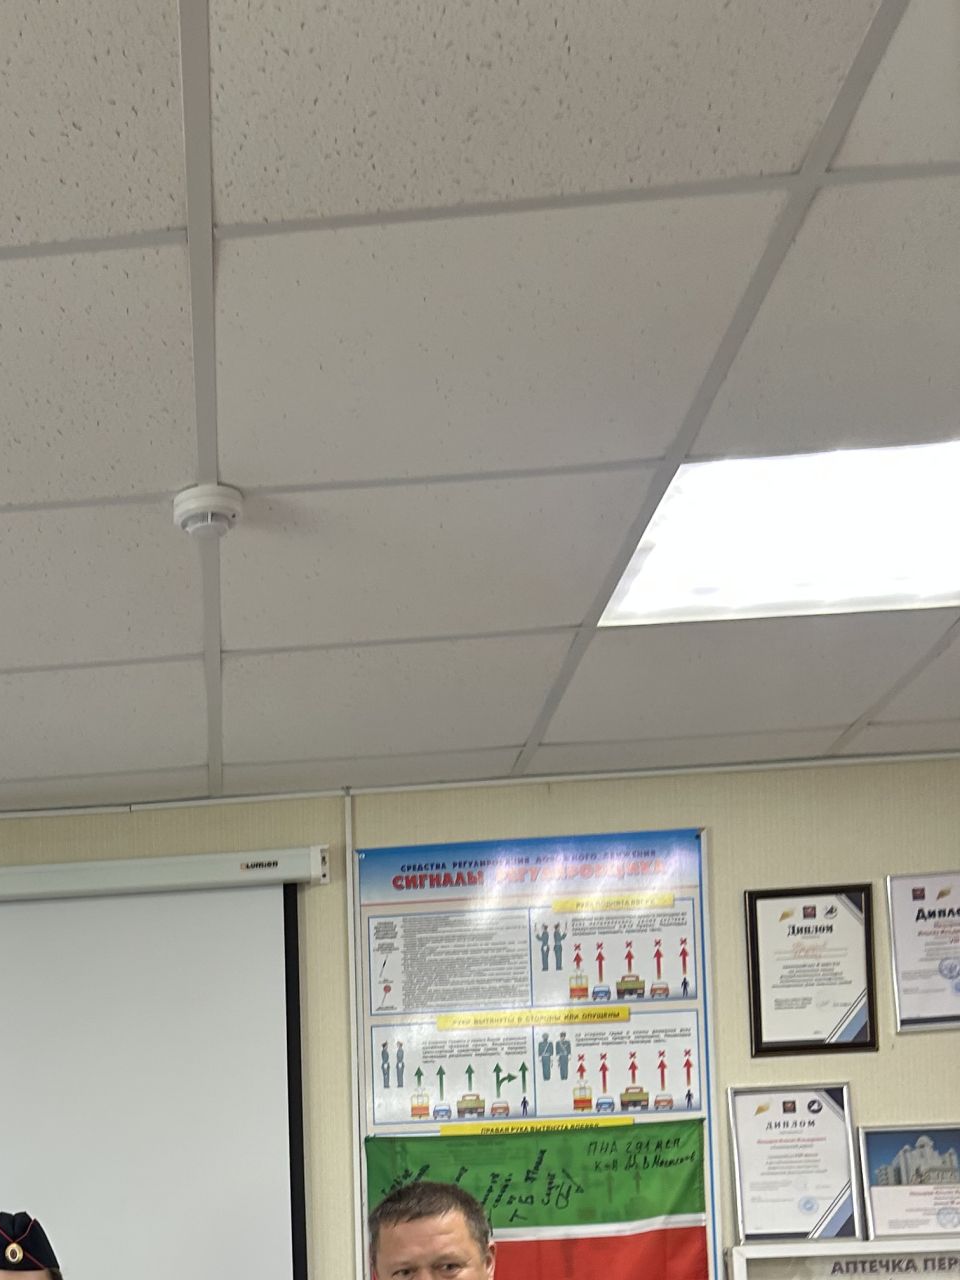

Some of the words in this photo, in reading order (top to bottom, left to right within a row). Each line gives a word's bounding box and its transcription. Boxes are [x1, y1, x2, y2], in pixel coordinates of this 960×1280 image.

[392, 870, 485, 891] СИГНАЛЫ
[787, 924, 833, 937] Диплом
[831, 1259, 918, 1275] АПТЕЧКА
